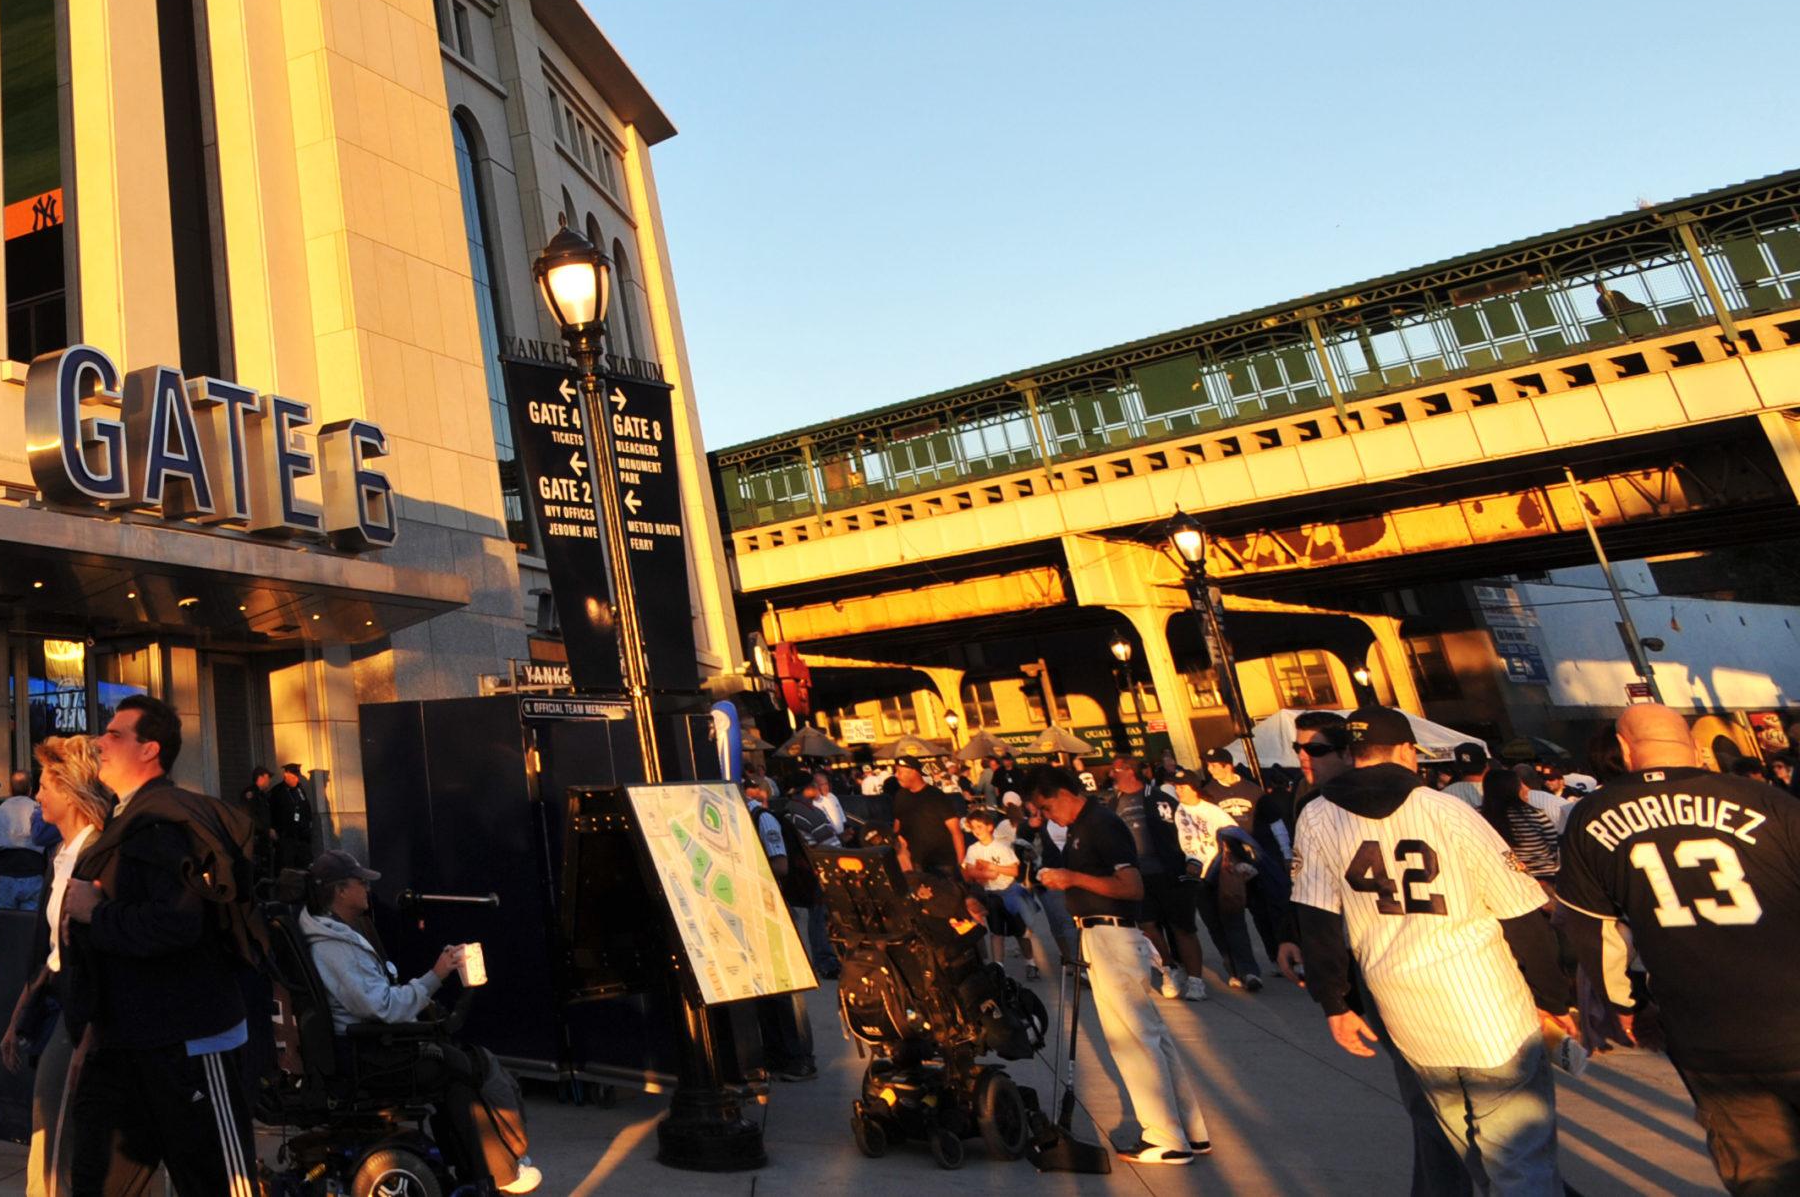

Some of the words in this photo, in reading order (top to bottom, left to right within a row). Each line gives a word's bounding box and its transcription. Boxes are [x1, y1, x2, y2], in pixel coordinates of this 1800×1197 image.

[506, 336, 576, 366] YANKEE
[605, 354, 664, 381] STADIUM
[529, 401, 569, 428] GATE
[572, 408, 582, 430] 4
[612, 414, 650, 440] GATE
[653, 420, 663, 442] 8
[57, 344, 324, 534] GATE
[350, 418, 399, 548] 6
[552, 431, 584, 446] TICKETS
[616, 441, 659, 458] BLEACHERS
[618, 457, 662, 474] MONUMENT
[620, 472, 641, 485] PARK
[539, 476, 580, 502] GATE
[582, 484, 593, 503] 2
[544, 504, 561, 517] NYY
[564, 506, 595, 521] OFFICES
[549, 523, 581, 538] JEROME
[583, 525, 598, 539] AVE
[627, 520, 653, 535] METRO
[656, 523, 681, 537] NORTH
[630, 538, 653, 551] FERRY
[525, 666, 572, 685] YANKE
[534, 702, 564, 714] OFFICIAL
[565, 703, 584, 714] TEAM
[1586, 793, 1767, 852] RODRIGUEZ
[1344, 839, 1448, 916] 42
[1629, 838, 1763, 928] 13
